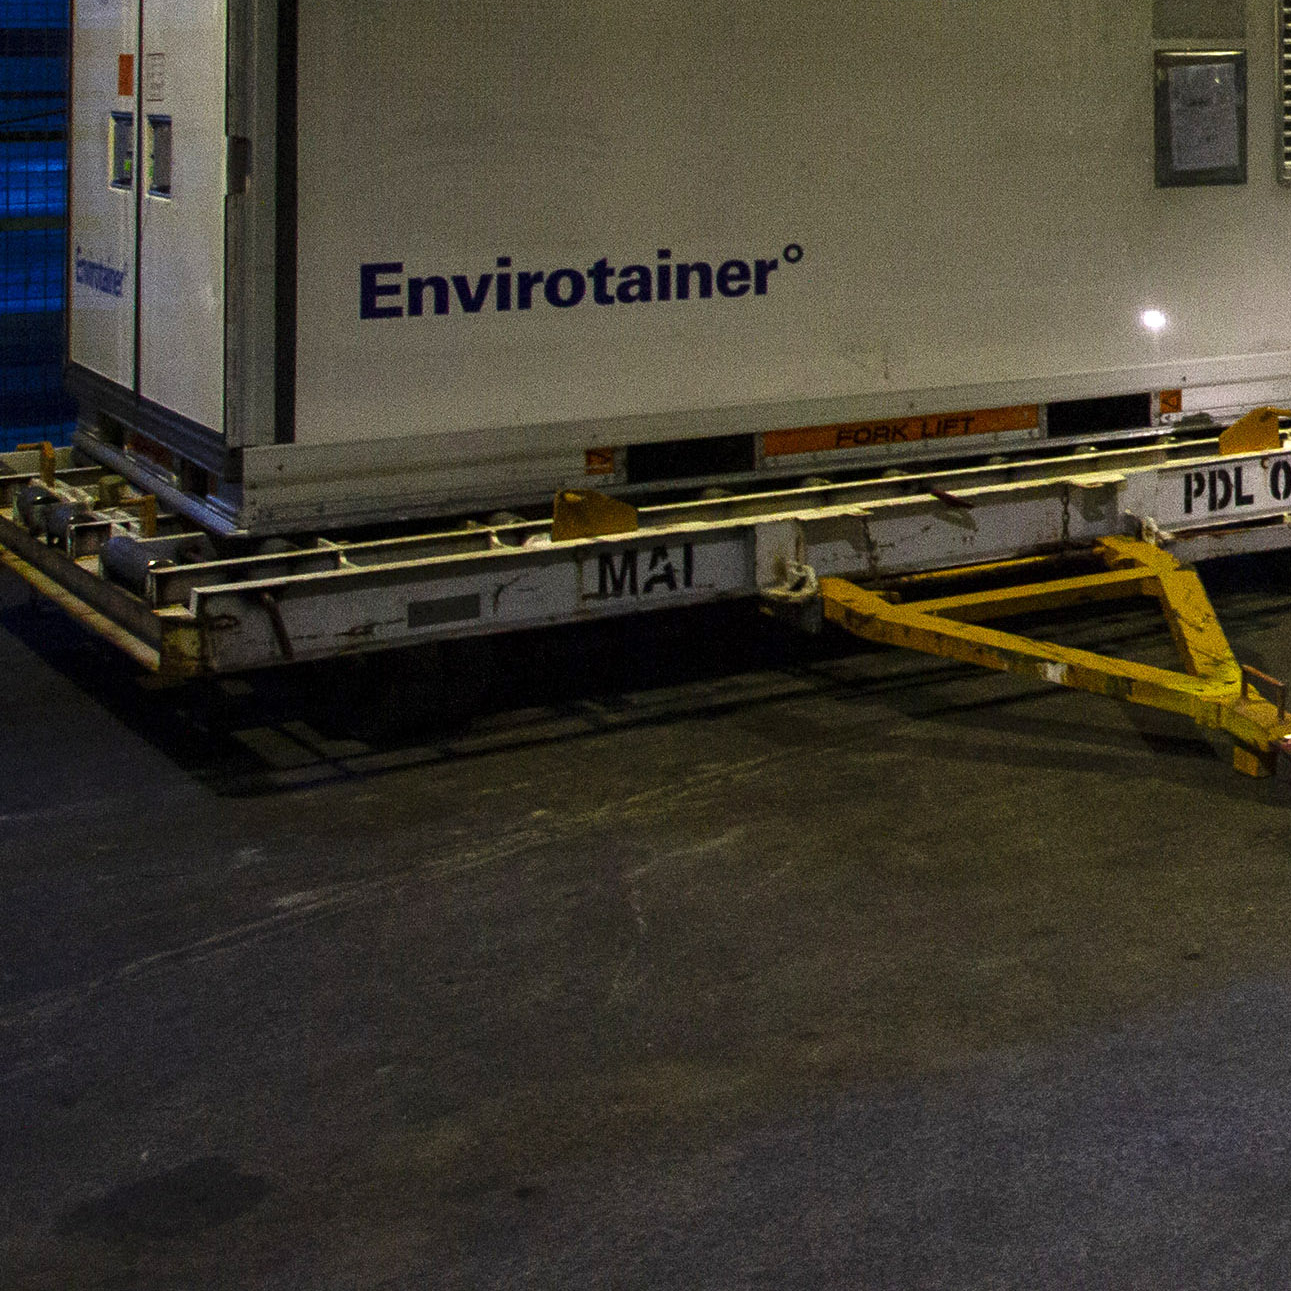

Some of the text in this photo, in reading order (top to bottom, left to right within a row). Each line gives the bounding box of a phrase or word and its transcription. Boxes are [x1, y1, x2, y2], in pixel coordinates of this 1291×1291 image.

[836, 416, 976, 450] FORK LIFT
[1183, 465, 1254, 514] PDL
